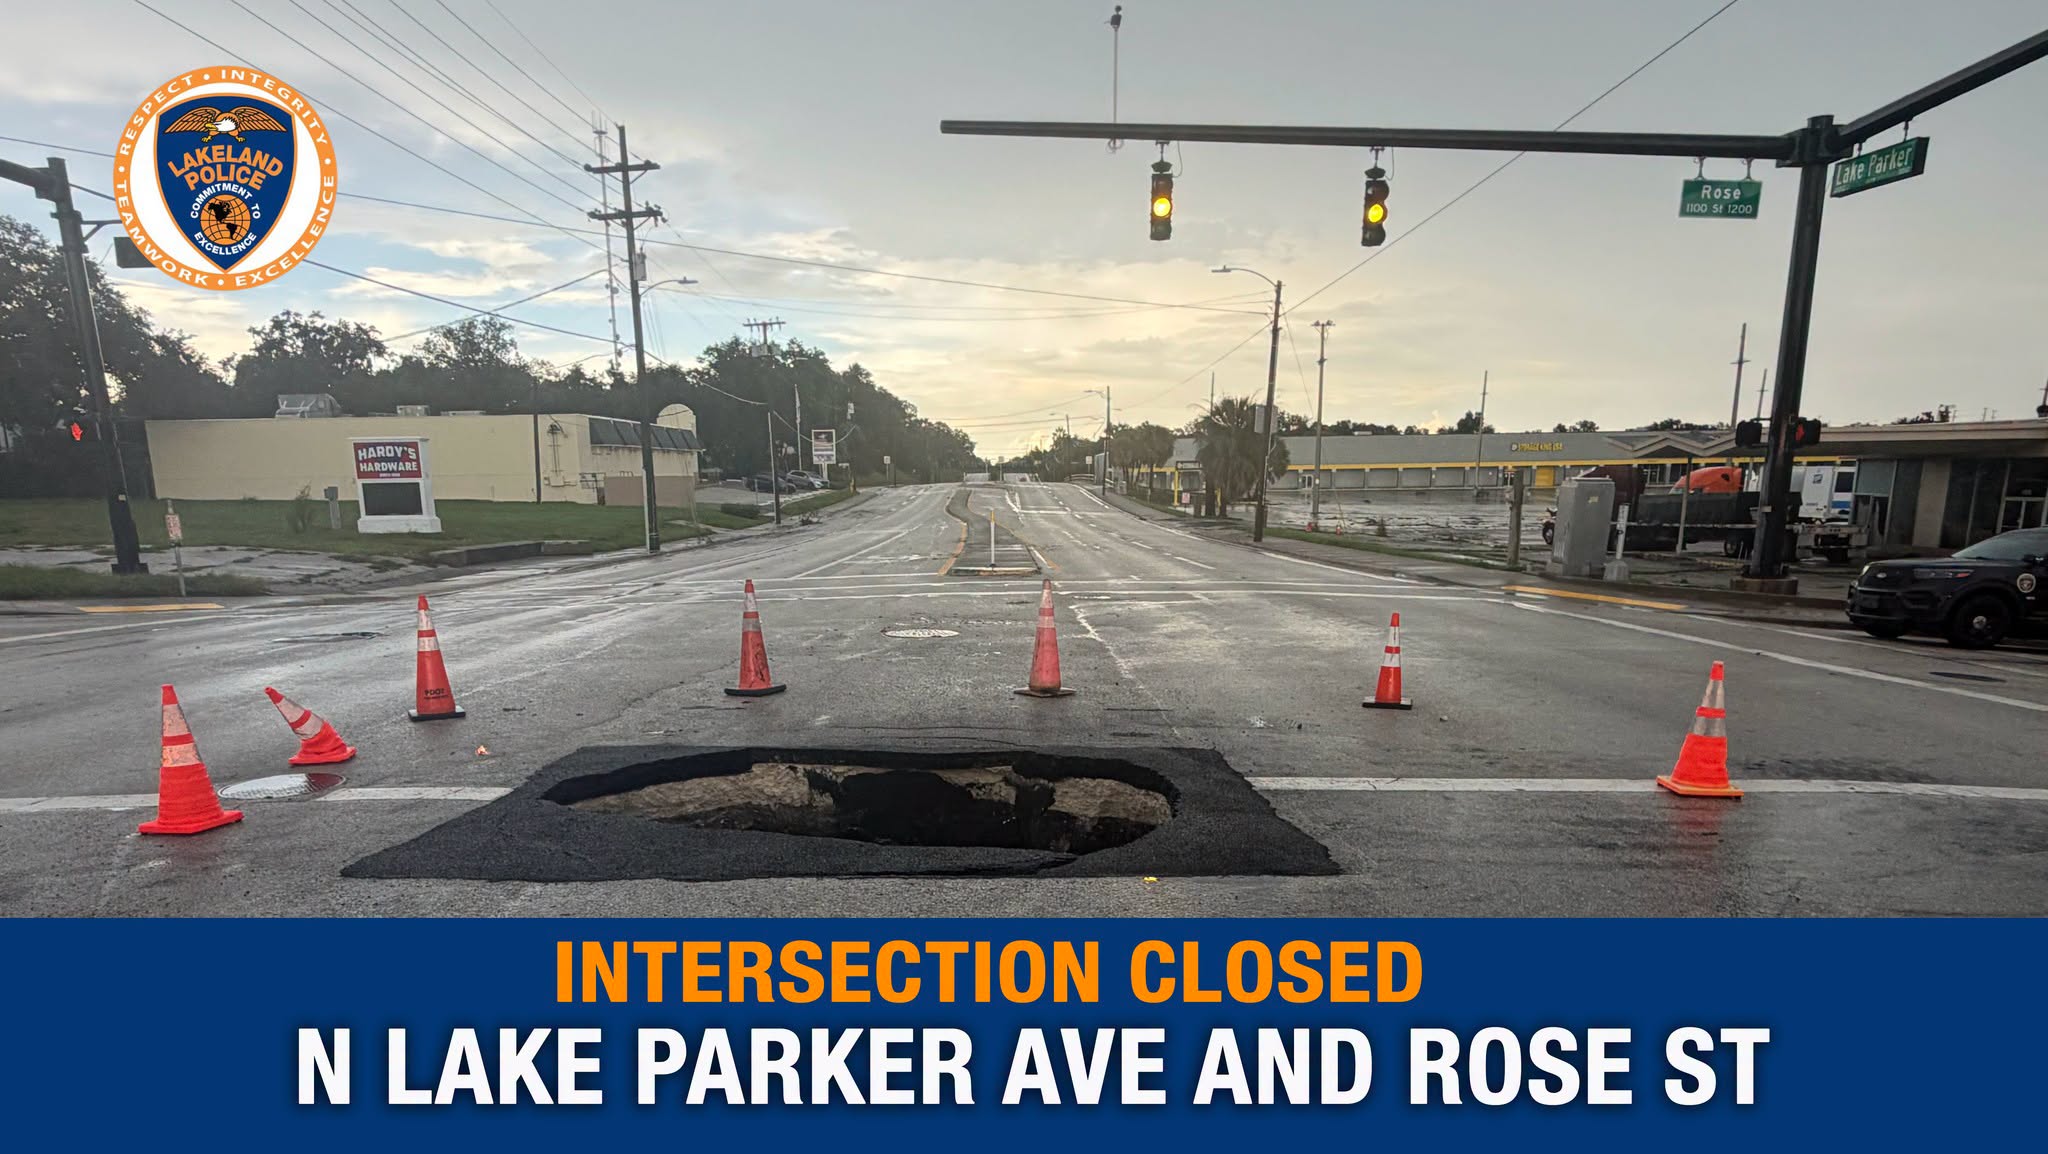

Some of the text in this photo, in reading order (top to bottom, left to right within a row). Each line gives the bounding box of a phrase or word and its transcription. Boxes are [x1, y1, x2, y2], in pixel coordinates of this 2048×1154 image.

[1836, 147, 1913, 185] Lake Parker
[1701, 185, 1741, 200] Rose
[1686, 203, 1753, 214] 1100 St 1200
[357, 445, 417, 461] HARDY'S
[359, 461, 418, 472] HARDWARE
